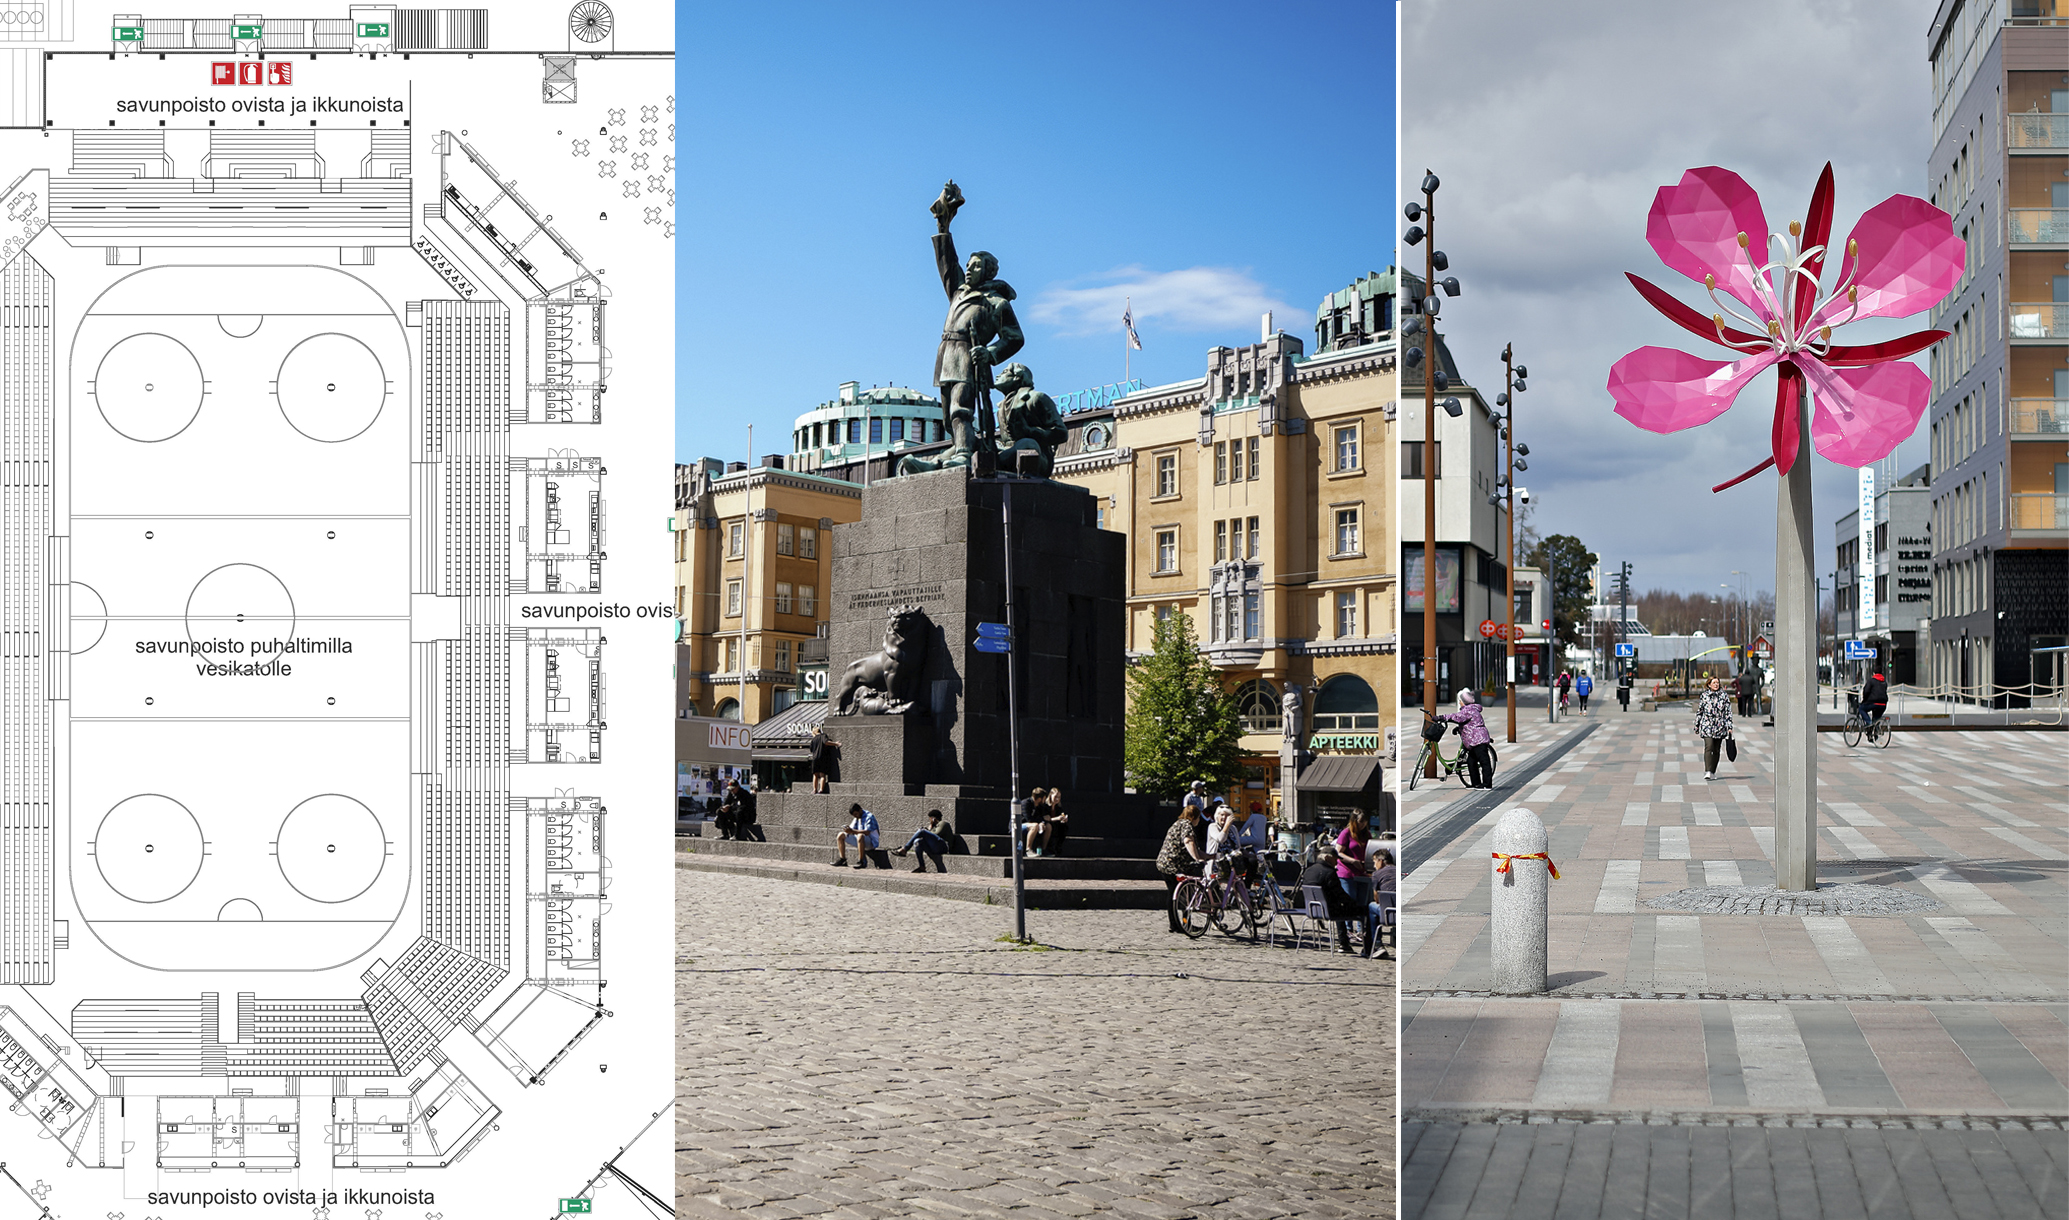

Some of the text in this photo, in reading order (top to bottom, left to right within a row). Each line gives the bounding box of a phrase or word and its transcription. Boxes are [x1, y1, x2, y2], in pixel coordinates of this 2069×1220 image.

[117, 96, 404, 117] savunpoisto ovista ja ikkunoista
[1058, 378, 1141, 413] RTMAN
[521, 602, 631, 622] savunpoisto
[135, 637, 352, 658] savunpoisto puhaltimilla
[196, 660, 292, 677] vesikatolle
[804, 670, 829, 694] SO
[710, 726, 751, 748] INFO
[1309, 736, 1377, 749] APTEEKKI
[148, 1188, 435, 1209] savunpoisto ovista ja ikkunoista
